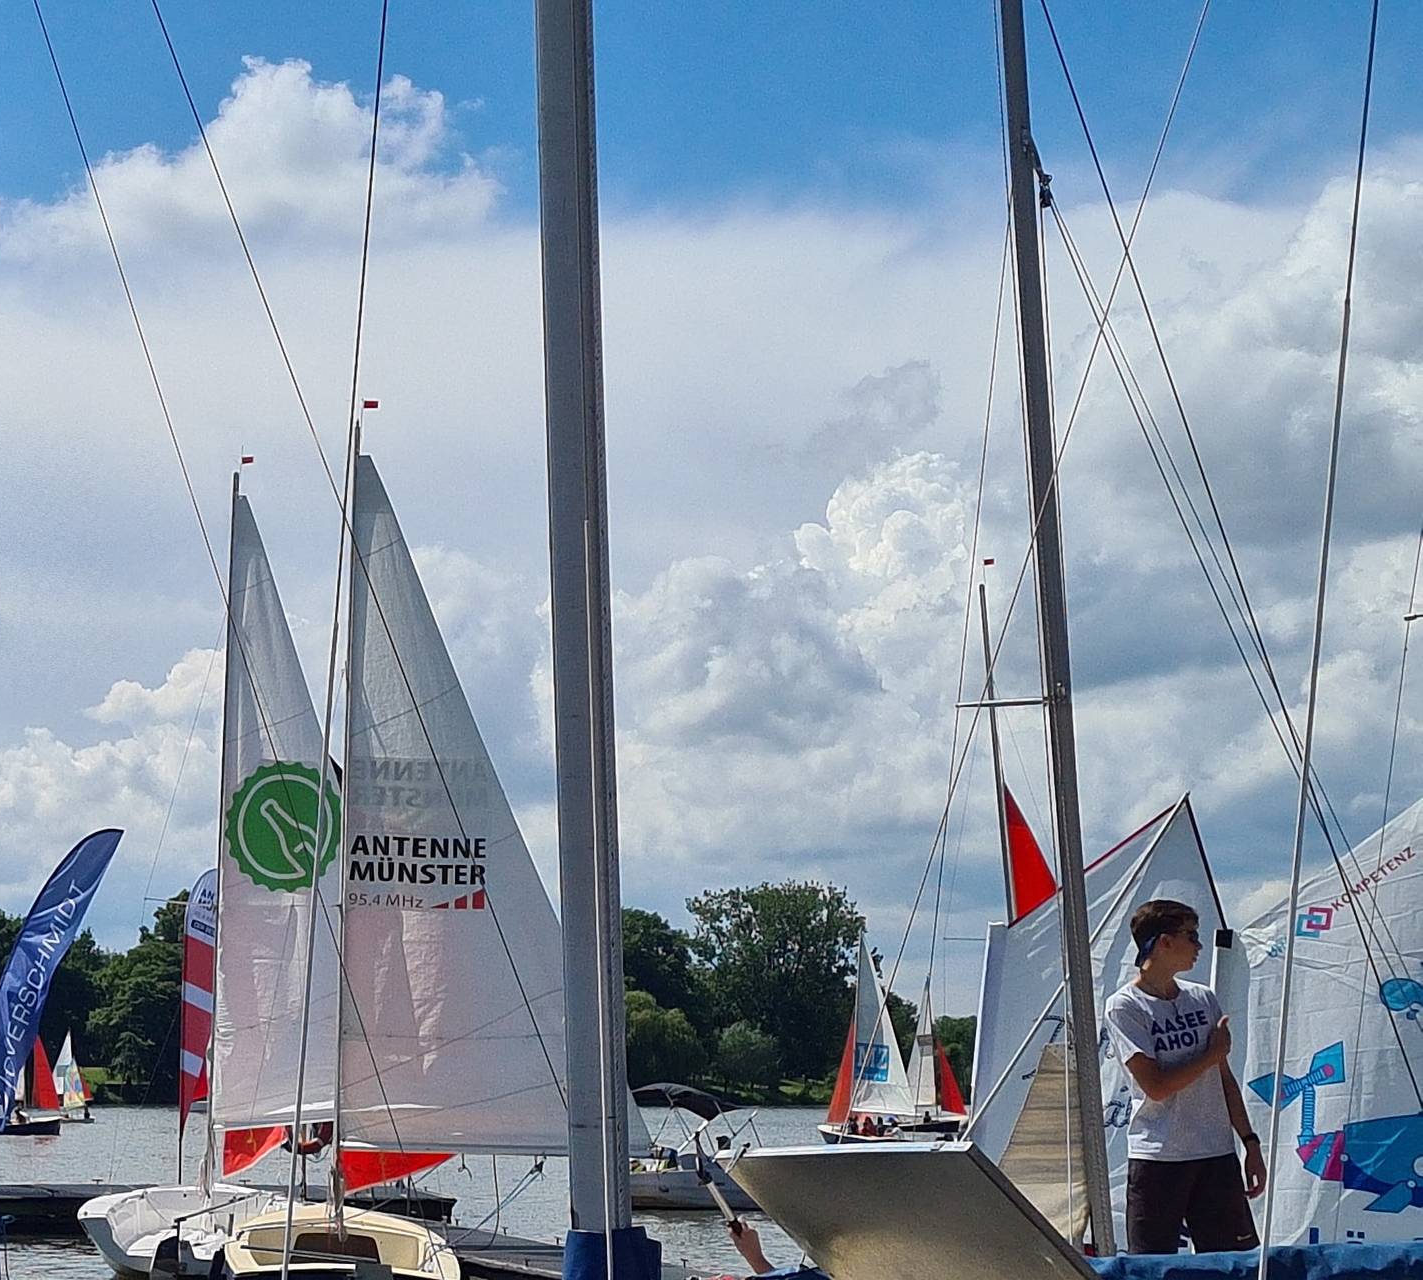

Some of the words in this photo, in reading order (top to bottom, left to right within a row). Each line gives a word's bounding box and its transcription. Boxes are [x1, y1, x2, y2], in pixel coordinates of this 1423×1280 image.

[350, 835, 486, 858] ANTENNE
[349, 857, 485, 885] MÜNSTER
[1330, 846, 1416, 911] KOMPETENZ
[348, 892, 380, 907] 95.4
[385, 893, 425, 908] MHz
[1151, 1010, 1208, 1036] AASEE
[1154, 1029, 1199, 1052] AHOI
